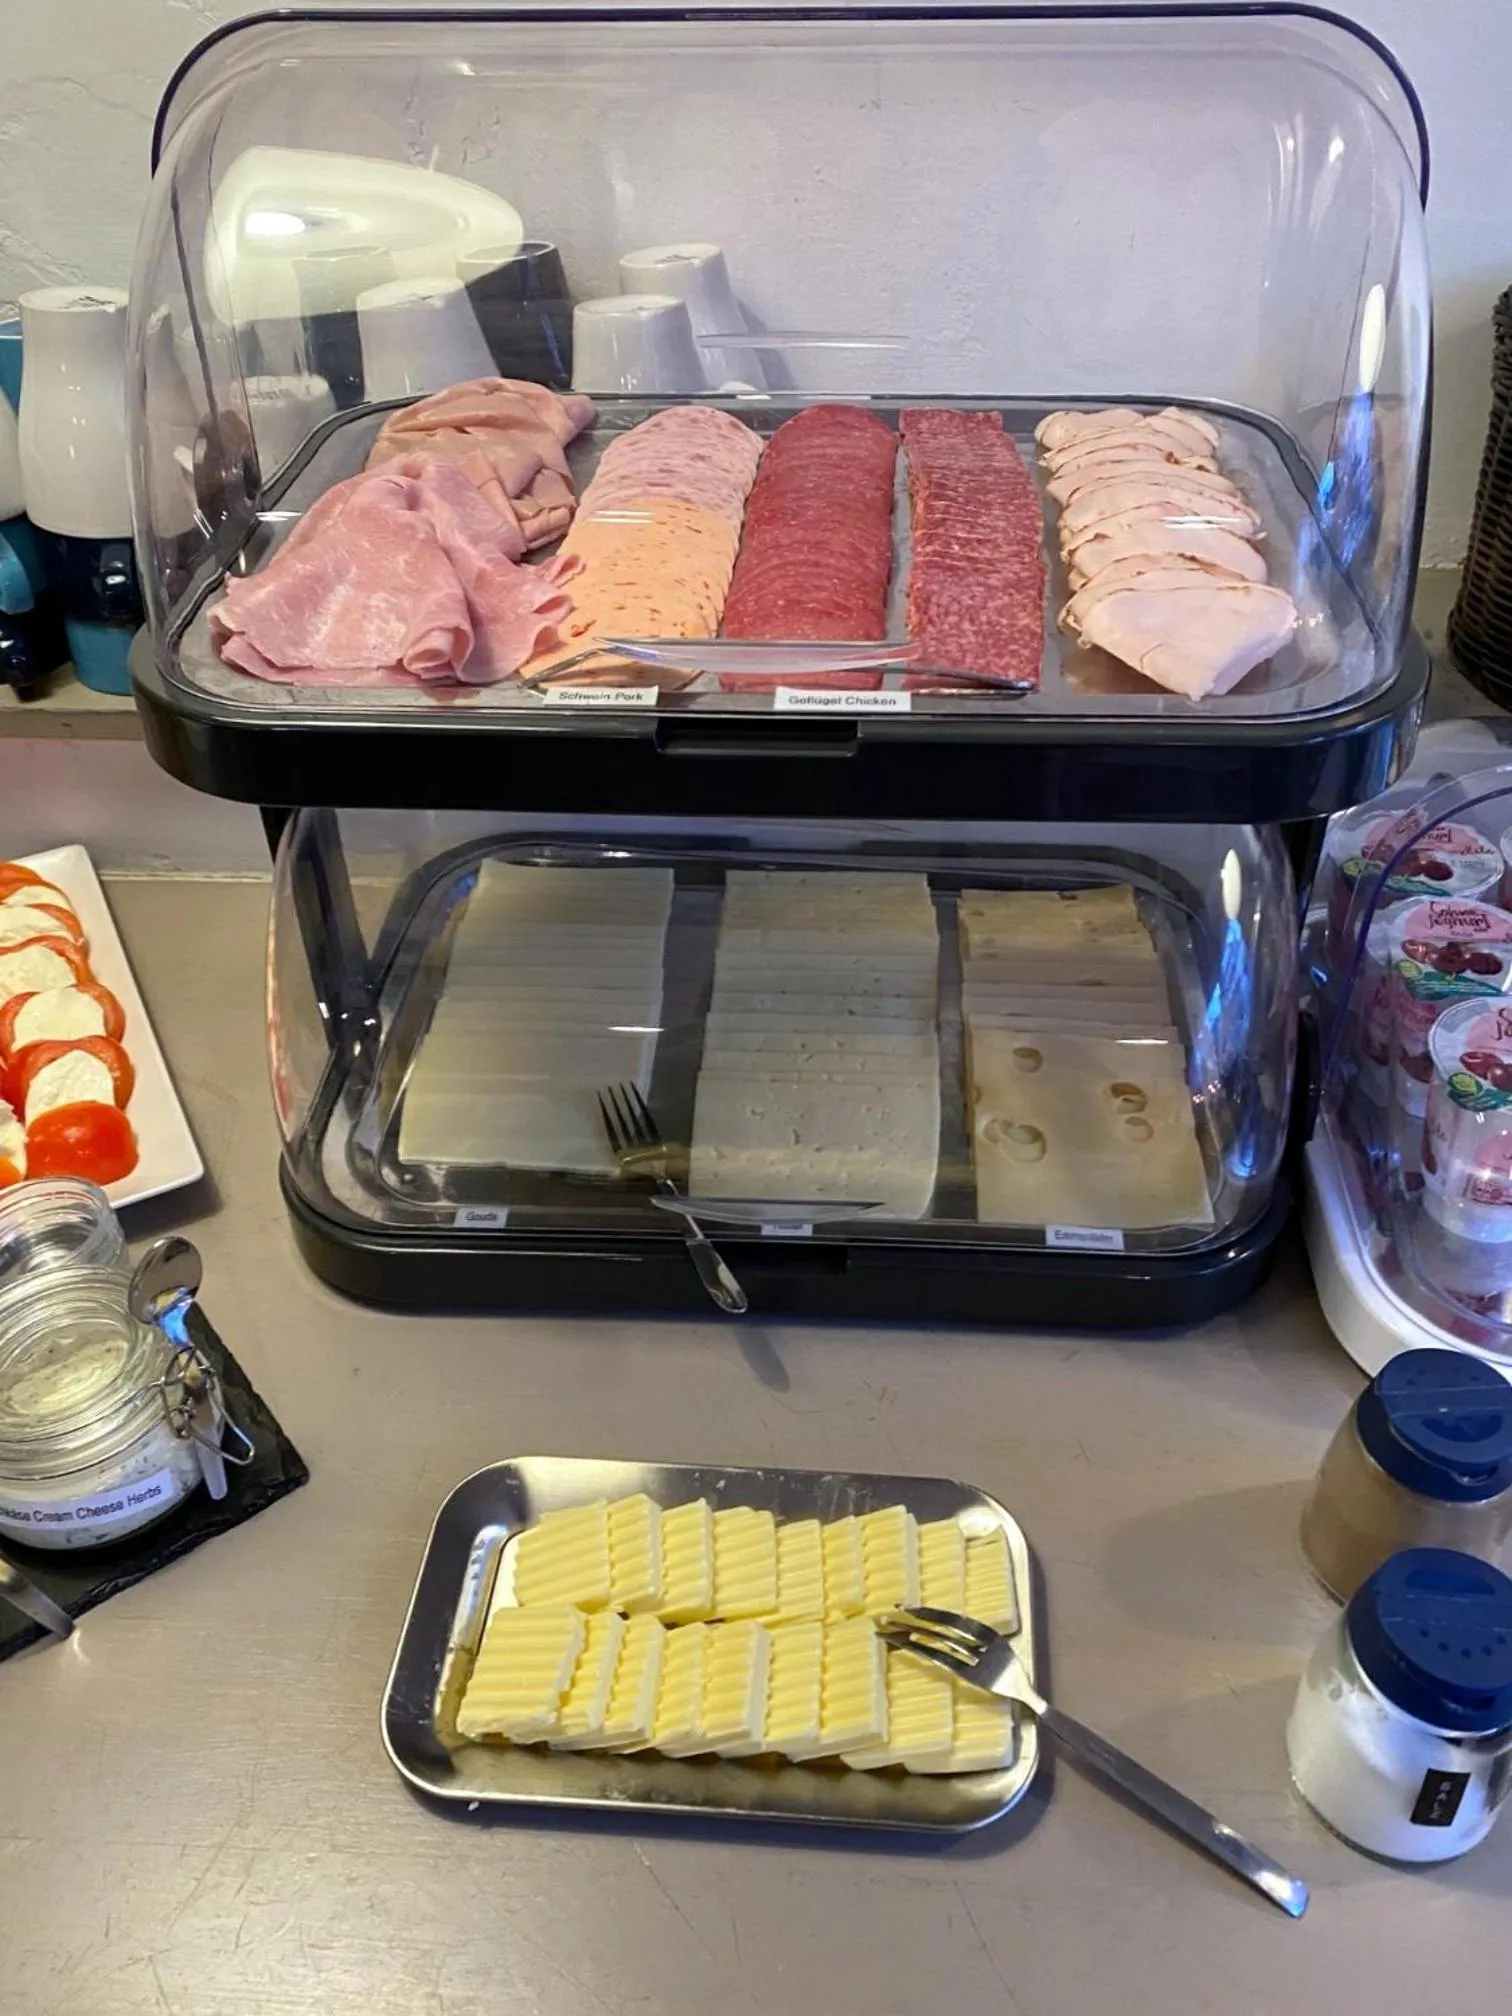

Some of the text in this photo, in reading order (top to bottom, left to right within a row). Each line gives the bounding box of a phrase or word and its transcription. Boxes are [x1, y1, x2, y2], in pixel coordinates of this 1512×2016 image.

[615, 691, 644, 701] Pork
[844, 695, 897, 706] Chicken
[33, 1509, 74, 1522] Cream
[76, 1500, 124, 1520] Cheese
[127, 1484, 162, 1507] Herbs
